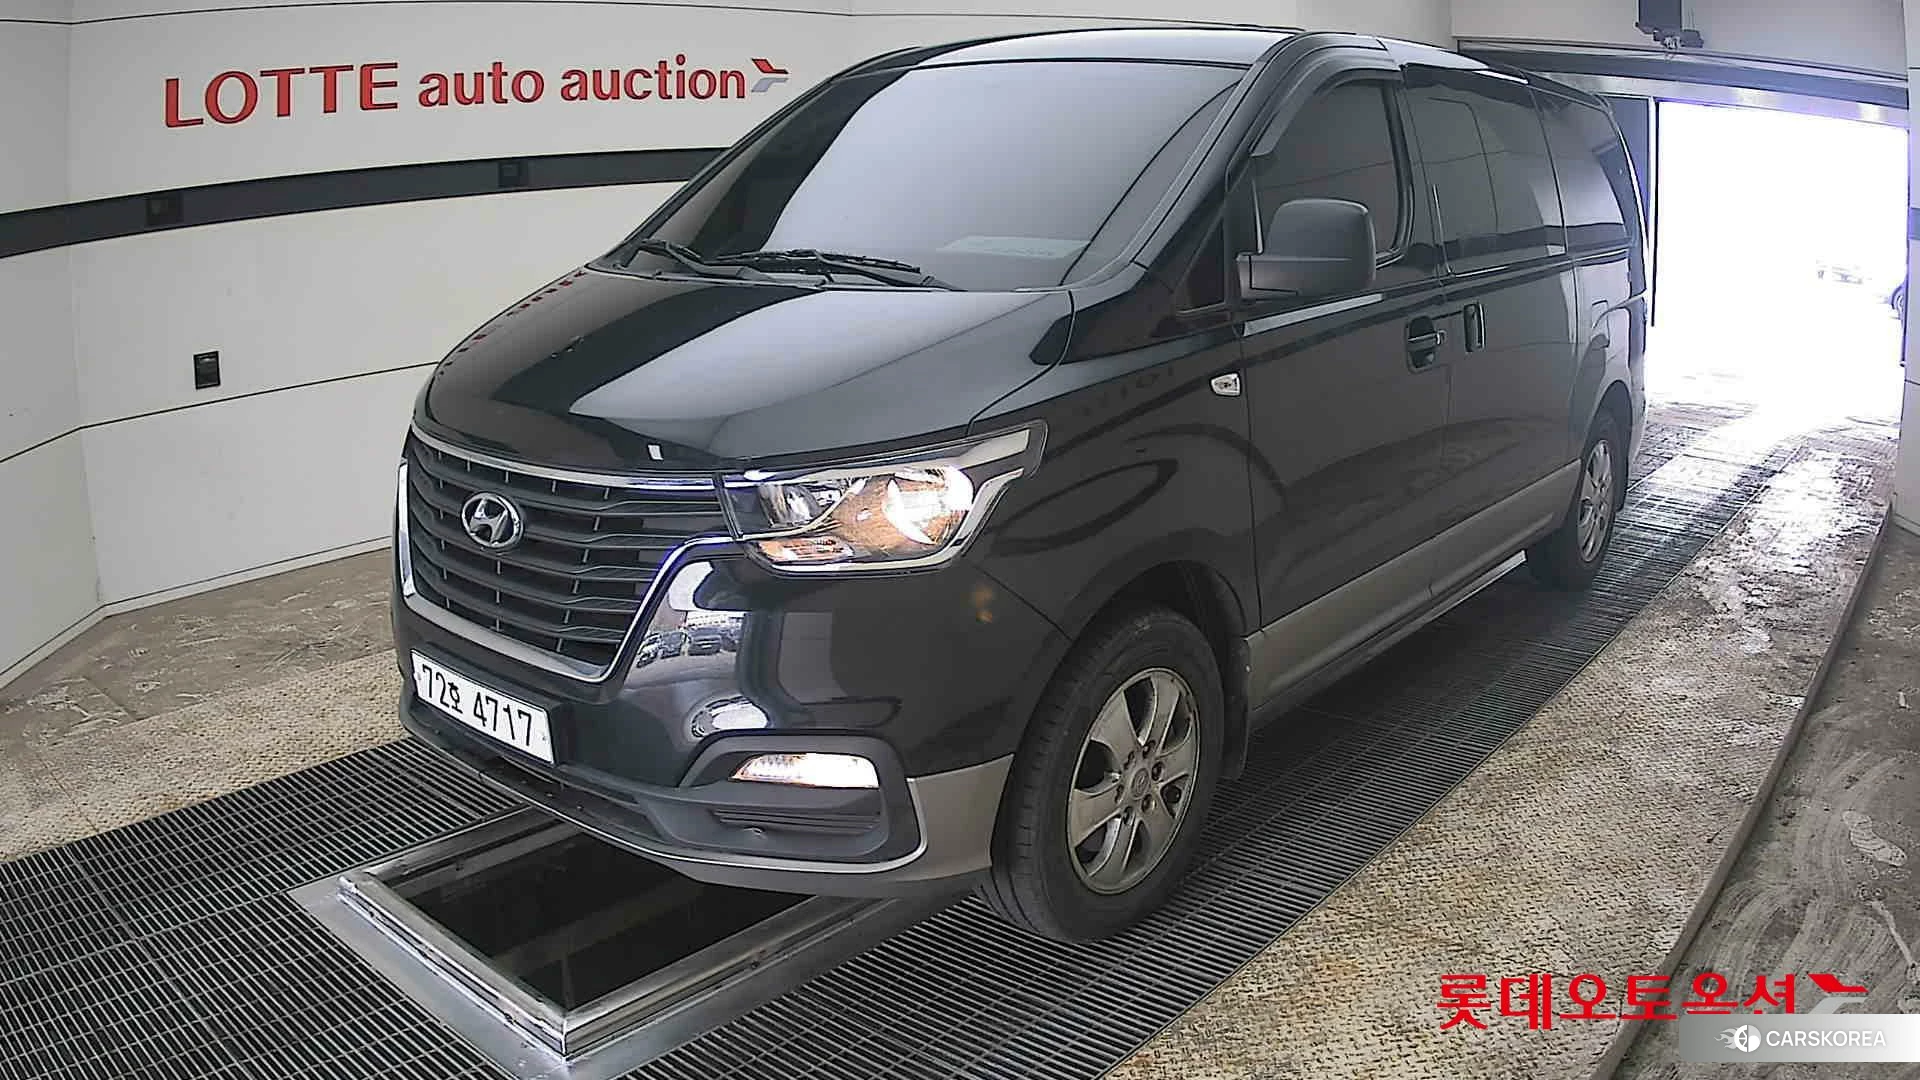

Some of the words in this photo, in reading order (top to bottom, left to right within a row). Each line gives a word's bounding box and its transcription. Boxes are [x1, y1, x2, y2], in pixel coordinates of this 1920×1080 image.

[164, 62, 399, 129] LOTTE
[418, 61, 546, 107] auto
[559, 53, 747, 101] auction
[422, 663, 464, 714] 72호
[473, 691, 532, 747] 4717
